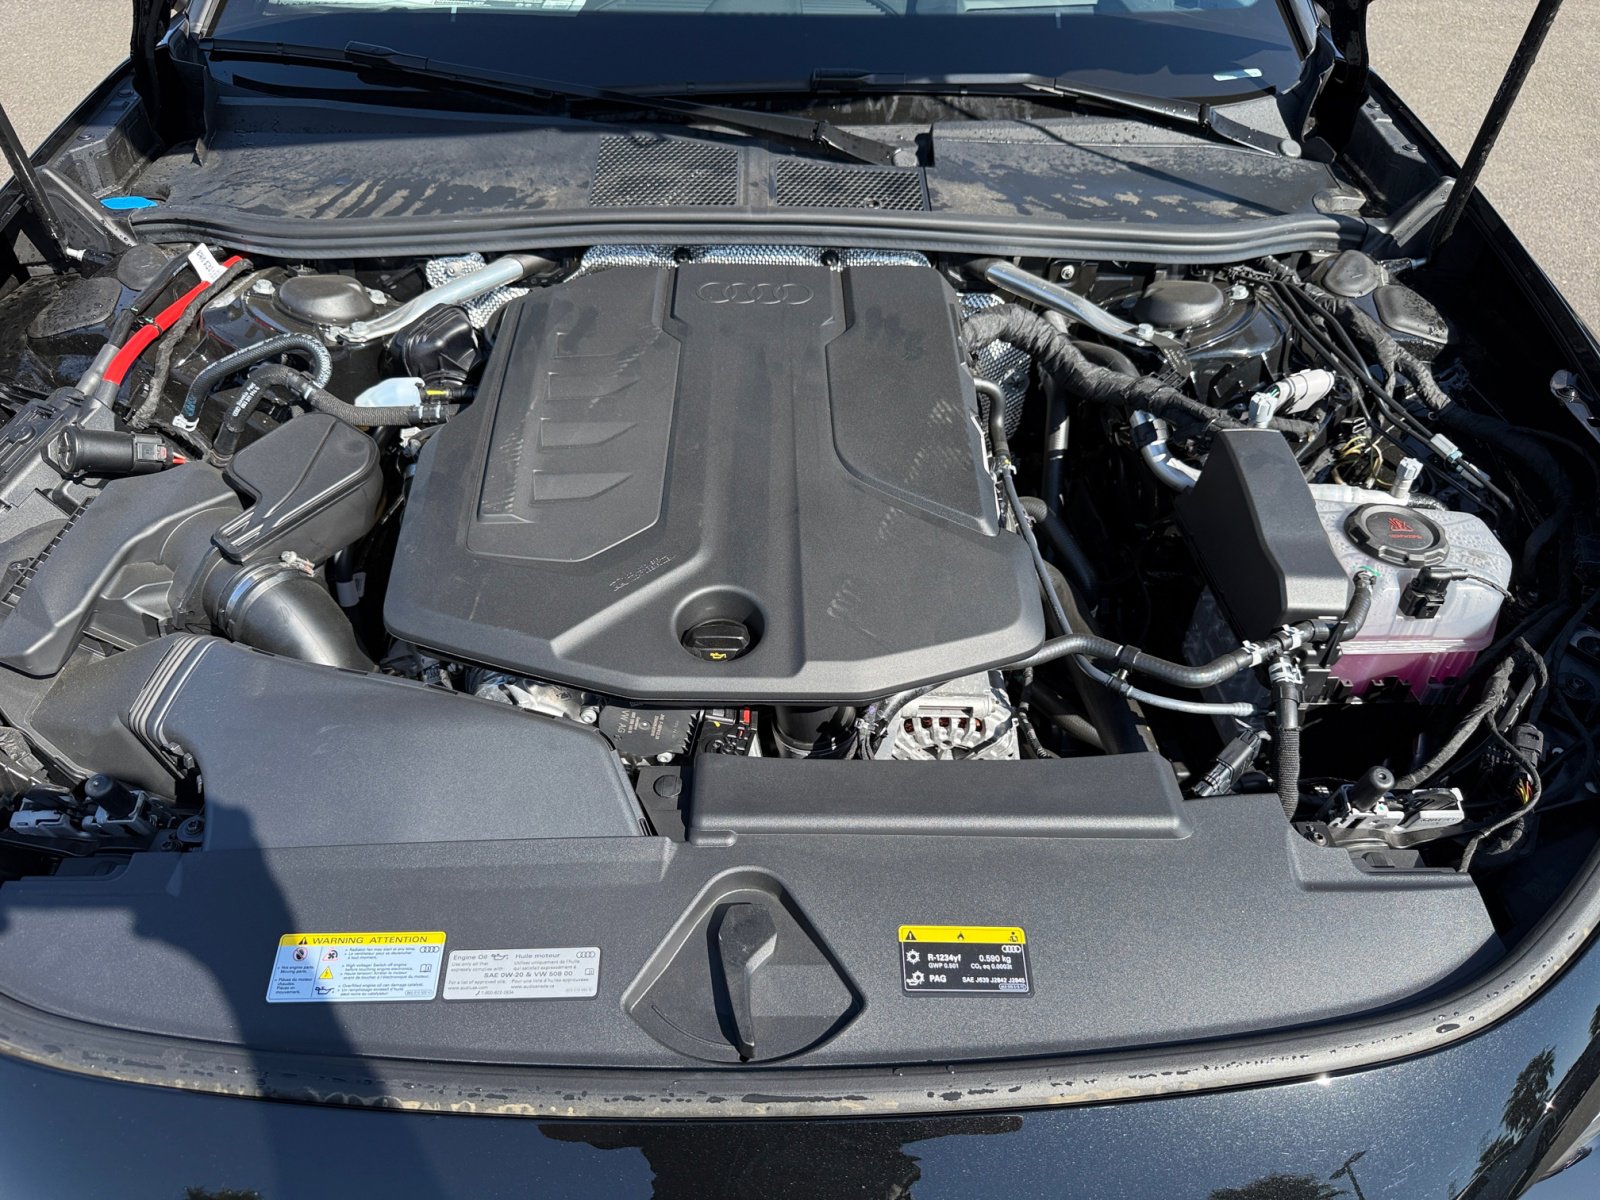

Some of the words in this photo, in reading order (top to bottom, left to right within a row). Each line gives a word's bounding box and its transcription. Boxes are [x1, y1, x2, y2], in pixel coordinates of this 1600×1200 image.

[617, 722, 627, 734] AG
[312, 936, 364, 944] WARNING
[369, 935, 428, 944] ATTENTION
[927, 953, 962, 962] R-1234yf
[1002, 955, 1012, 964] kg
[929, 974, 947, 983] PAG
